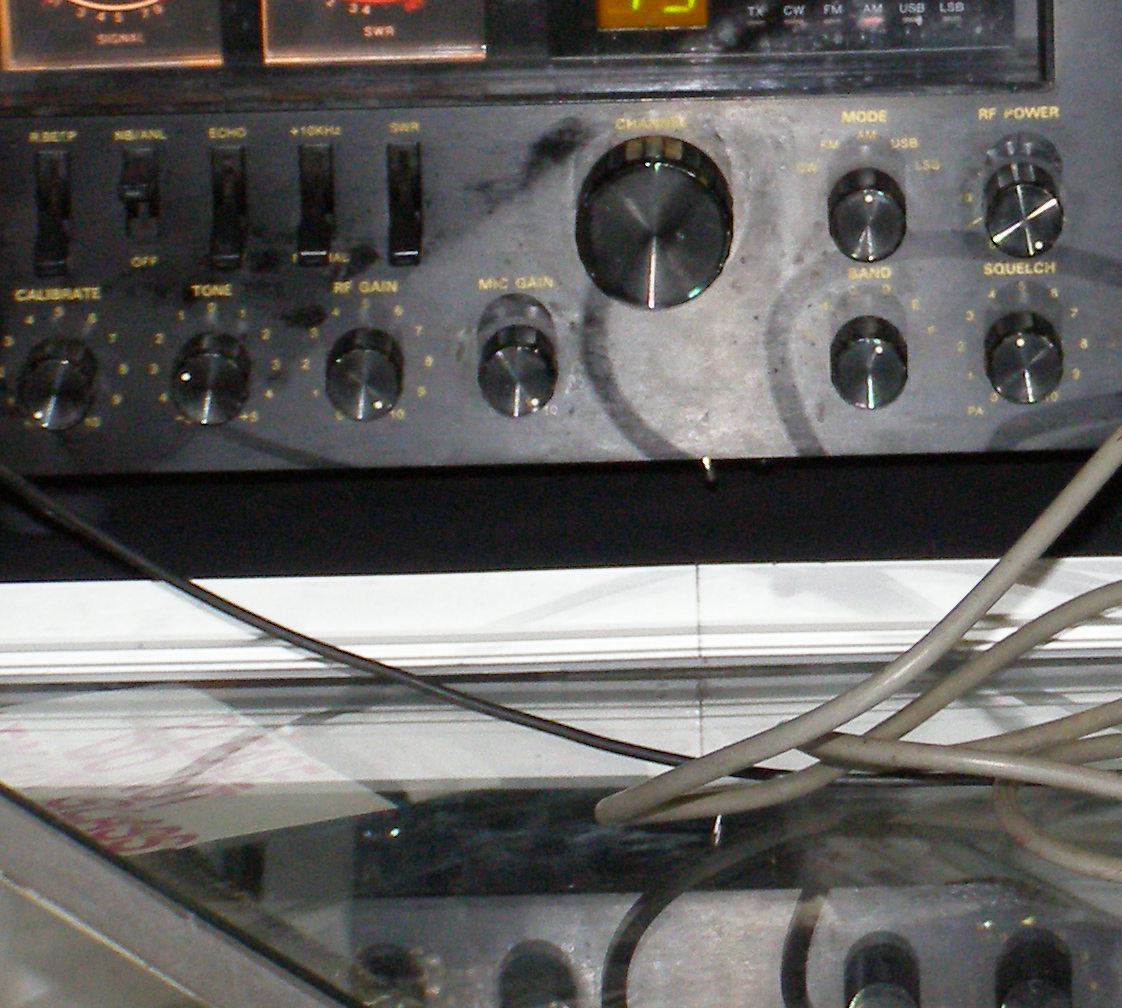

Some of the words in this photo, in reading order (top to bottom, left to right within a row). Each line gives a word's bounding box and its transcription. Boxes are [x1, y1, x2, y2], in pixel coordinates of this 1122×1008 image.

[747, 6, 765, 17] TX
[783, 4, 806, 17] CW
[824, 3, 843, 15] FM
[863, 3, 884, 14] AM
[899, 2, 926, 14] USB
[939, 1, 965, 13] LSB
[362, 25, 395, 37] SWR
[841, 109, 888, 123] MODE
[978, 107, 997, 121] RF
[1004, 106, 1060, 120] POWER
[208, 126, 247, 140] ECHO
[130, 255, 159, 268] OFF
[983, 261, 1056, 276] SQUELCH
[848, 267, 892, 280] BAND
[332, 281, 352, 294] RF
[358, 280, 399, 294] GAIN
[478, 277, 508, 290] MIC
[514, 276, 554, 290] GAIN
[14, 286, 101, 303] CALIBRATE
[191, 283, 232, 298] TONE
